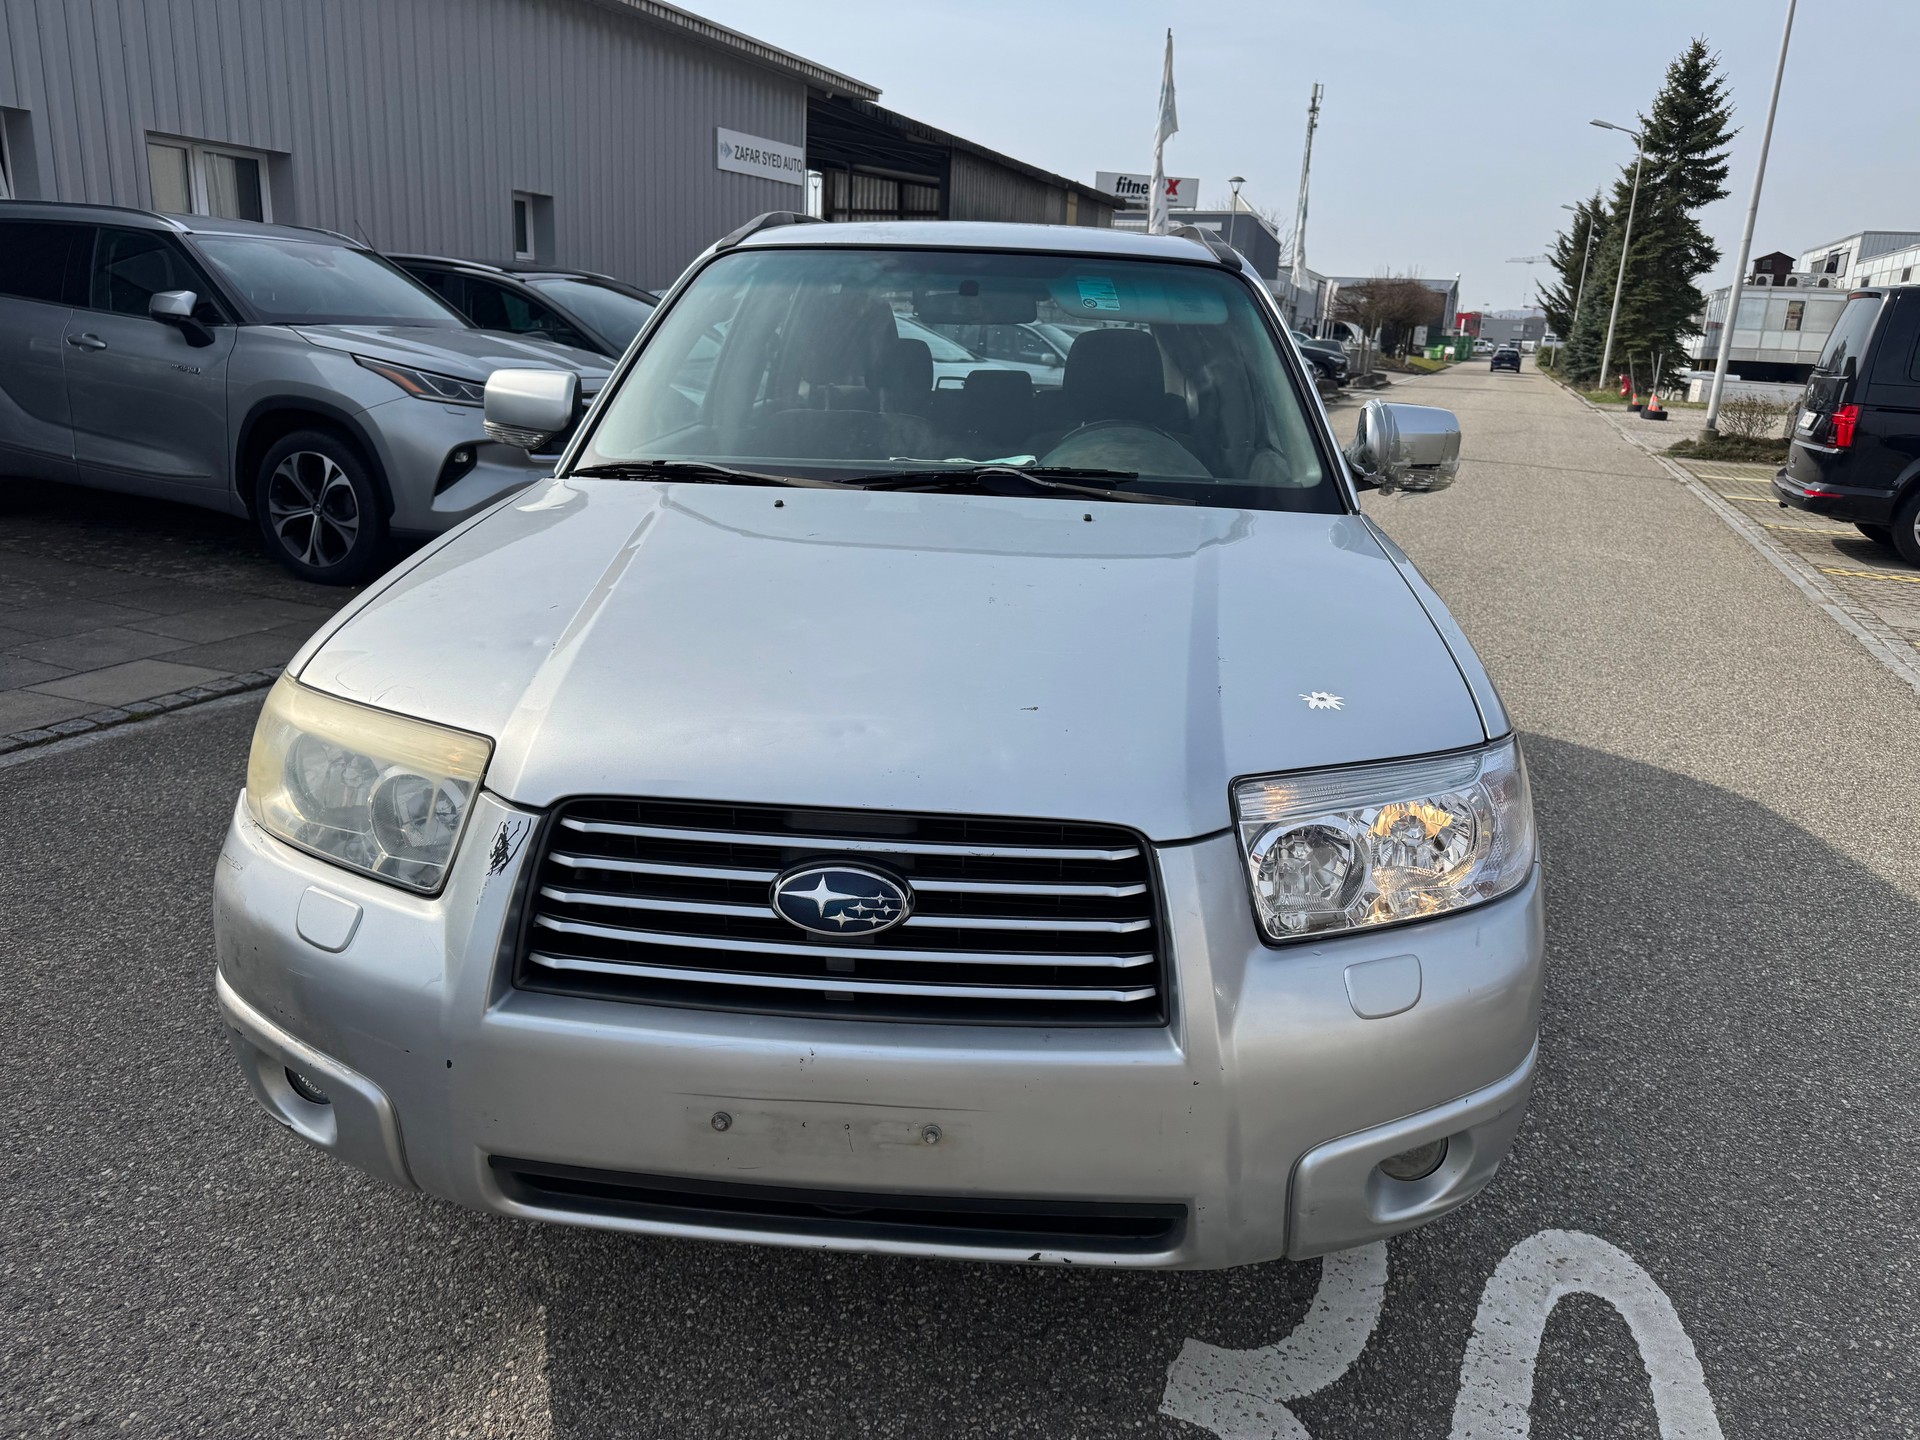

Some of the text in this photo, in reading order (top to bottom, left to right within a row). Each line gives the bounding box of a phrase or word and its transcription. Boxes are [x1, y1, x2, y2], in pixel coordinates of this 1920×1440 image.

[734, 145, 803, 173] ZAFAR SYED AUTO
